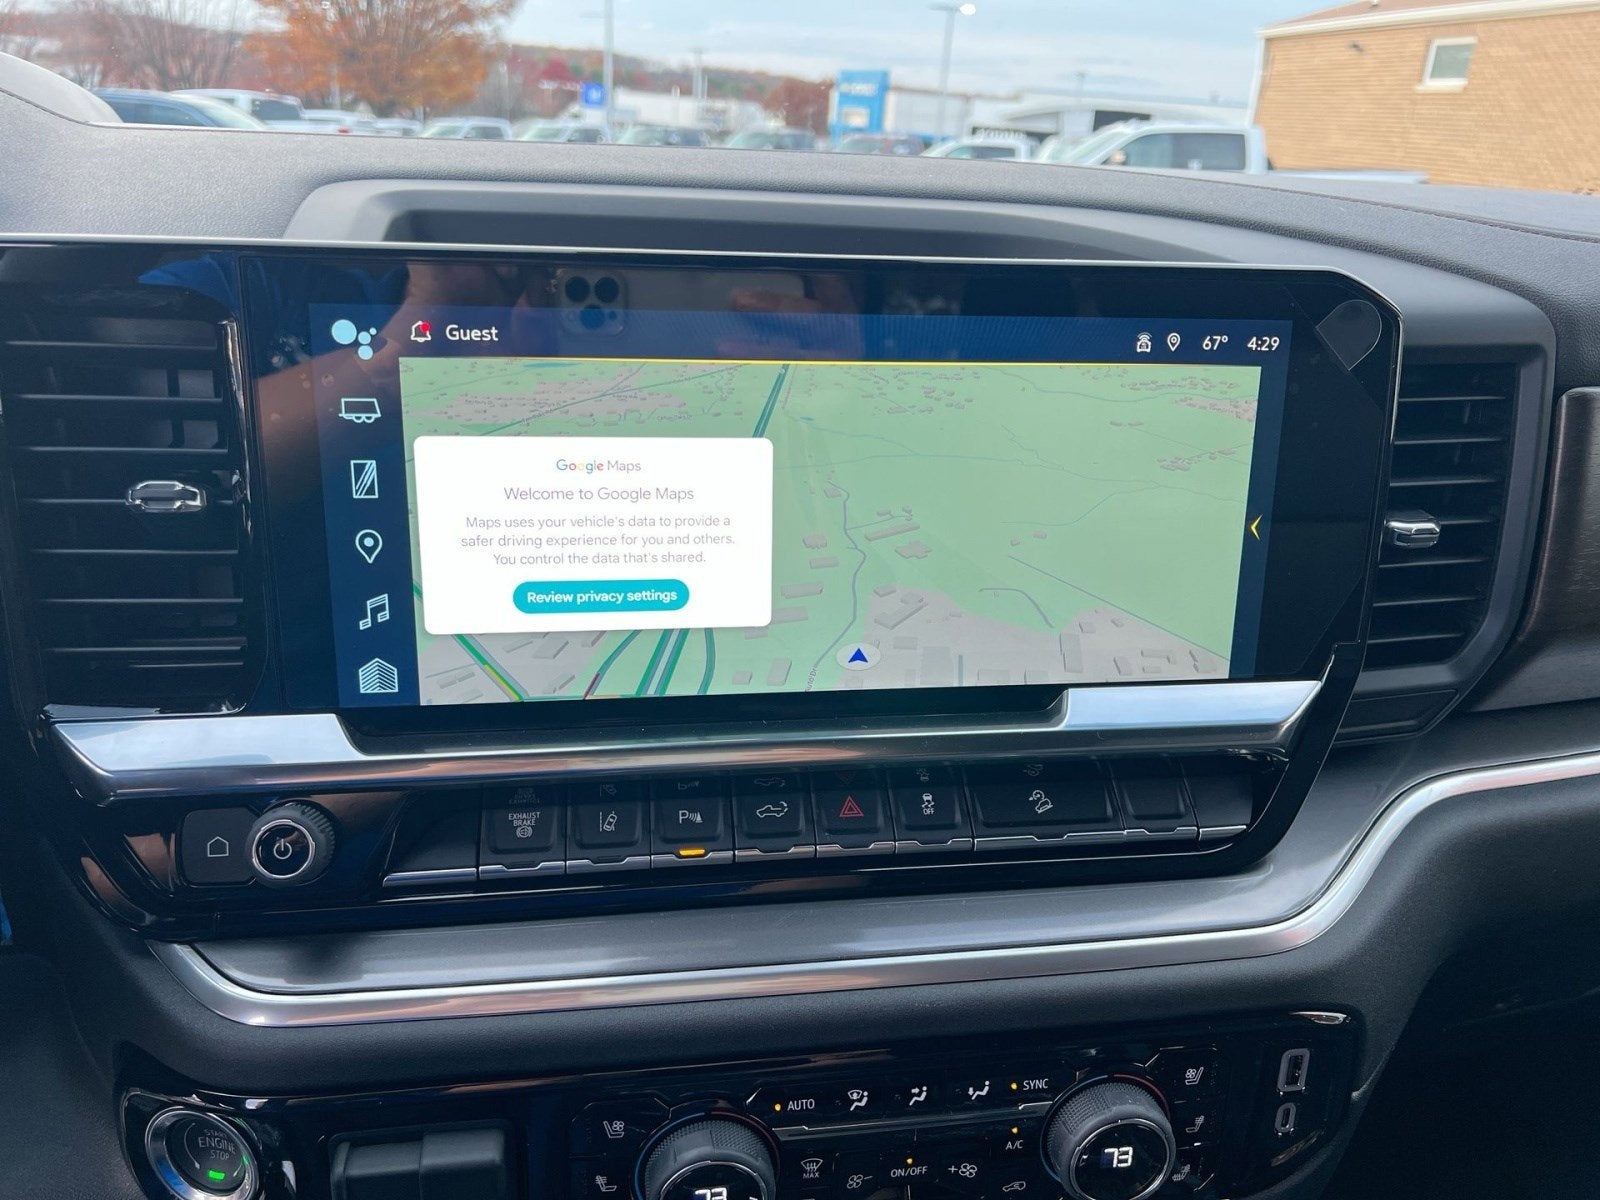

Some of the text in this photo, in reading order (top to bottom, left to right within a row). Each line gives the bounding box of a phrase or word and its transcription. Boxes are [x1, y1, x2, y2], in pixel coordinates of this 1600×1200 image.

[445, 324, 499, 341] Guest
[1202, 335, 1229, 351] 67°
[1247, 336, 1280, 351] 4:29
[556, 458, 642, 475] Google Maps
[504, 486, 695, 503] Welcome to Google Maps
[466, 515, 731, 530] Maps uses your vehicle's data to provide a
[461, 533, 736, 549] safer driving experience for you and others.
[493, 551, 706, 565] You control the data that's shared.
[527, 588, 678, 605] Review privacy settings
[508, 811, 541, 821] EXHAUST
[513, 818, 536, 827] BRAKE
[679, 810, 689, 824] P
[1023, 1078, 1049, 1091] SYNC
[787, 1099, 815, 1111] AUTO
[198, 1136, 236, 1155] ENGINE
[1005, 1140, 1024, 1150] A/C
[210, 1149, 230, 1161] STOP
[1104, 1146, 1133, 1168] 73
[803, 1171, 820, 1179] MAX
[890, 1165, 928, 1178] ON/OFF
